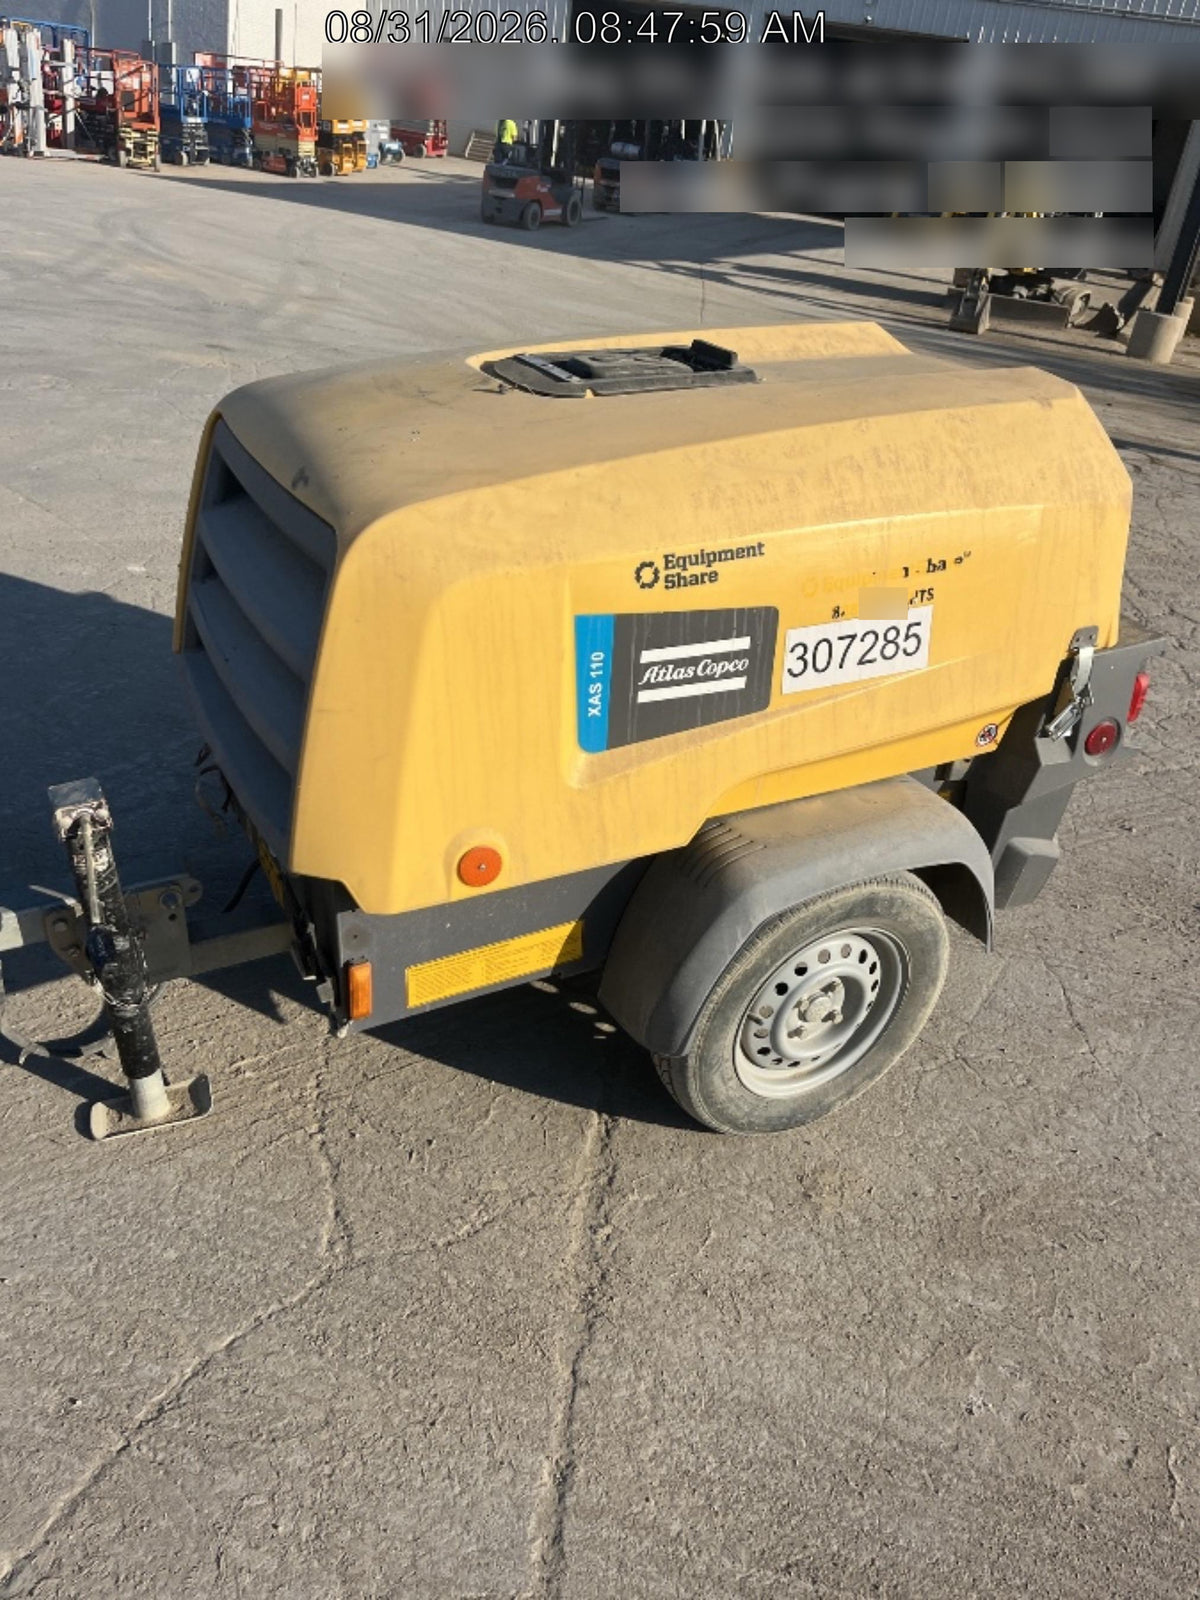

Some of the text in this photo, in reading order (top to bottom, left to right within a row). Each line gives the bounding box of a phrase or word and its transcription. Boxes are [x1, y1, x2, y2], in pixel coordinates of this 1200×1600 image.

[663, 541, 766, 571] Equipment
[664, 570, 719, 590] Share
[786, 621, 922, 678] 307285
[588, 651, 606, 718] XAS 110
[637, 658, 750, 686] Atlas Copco
